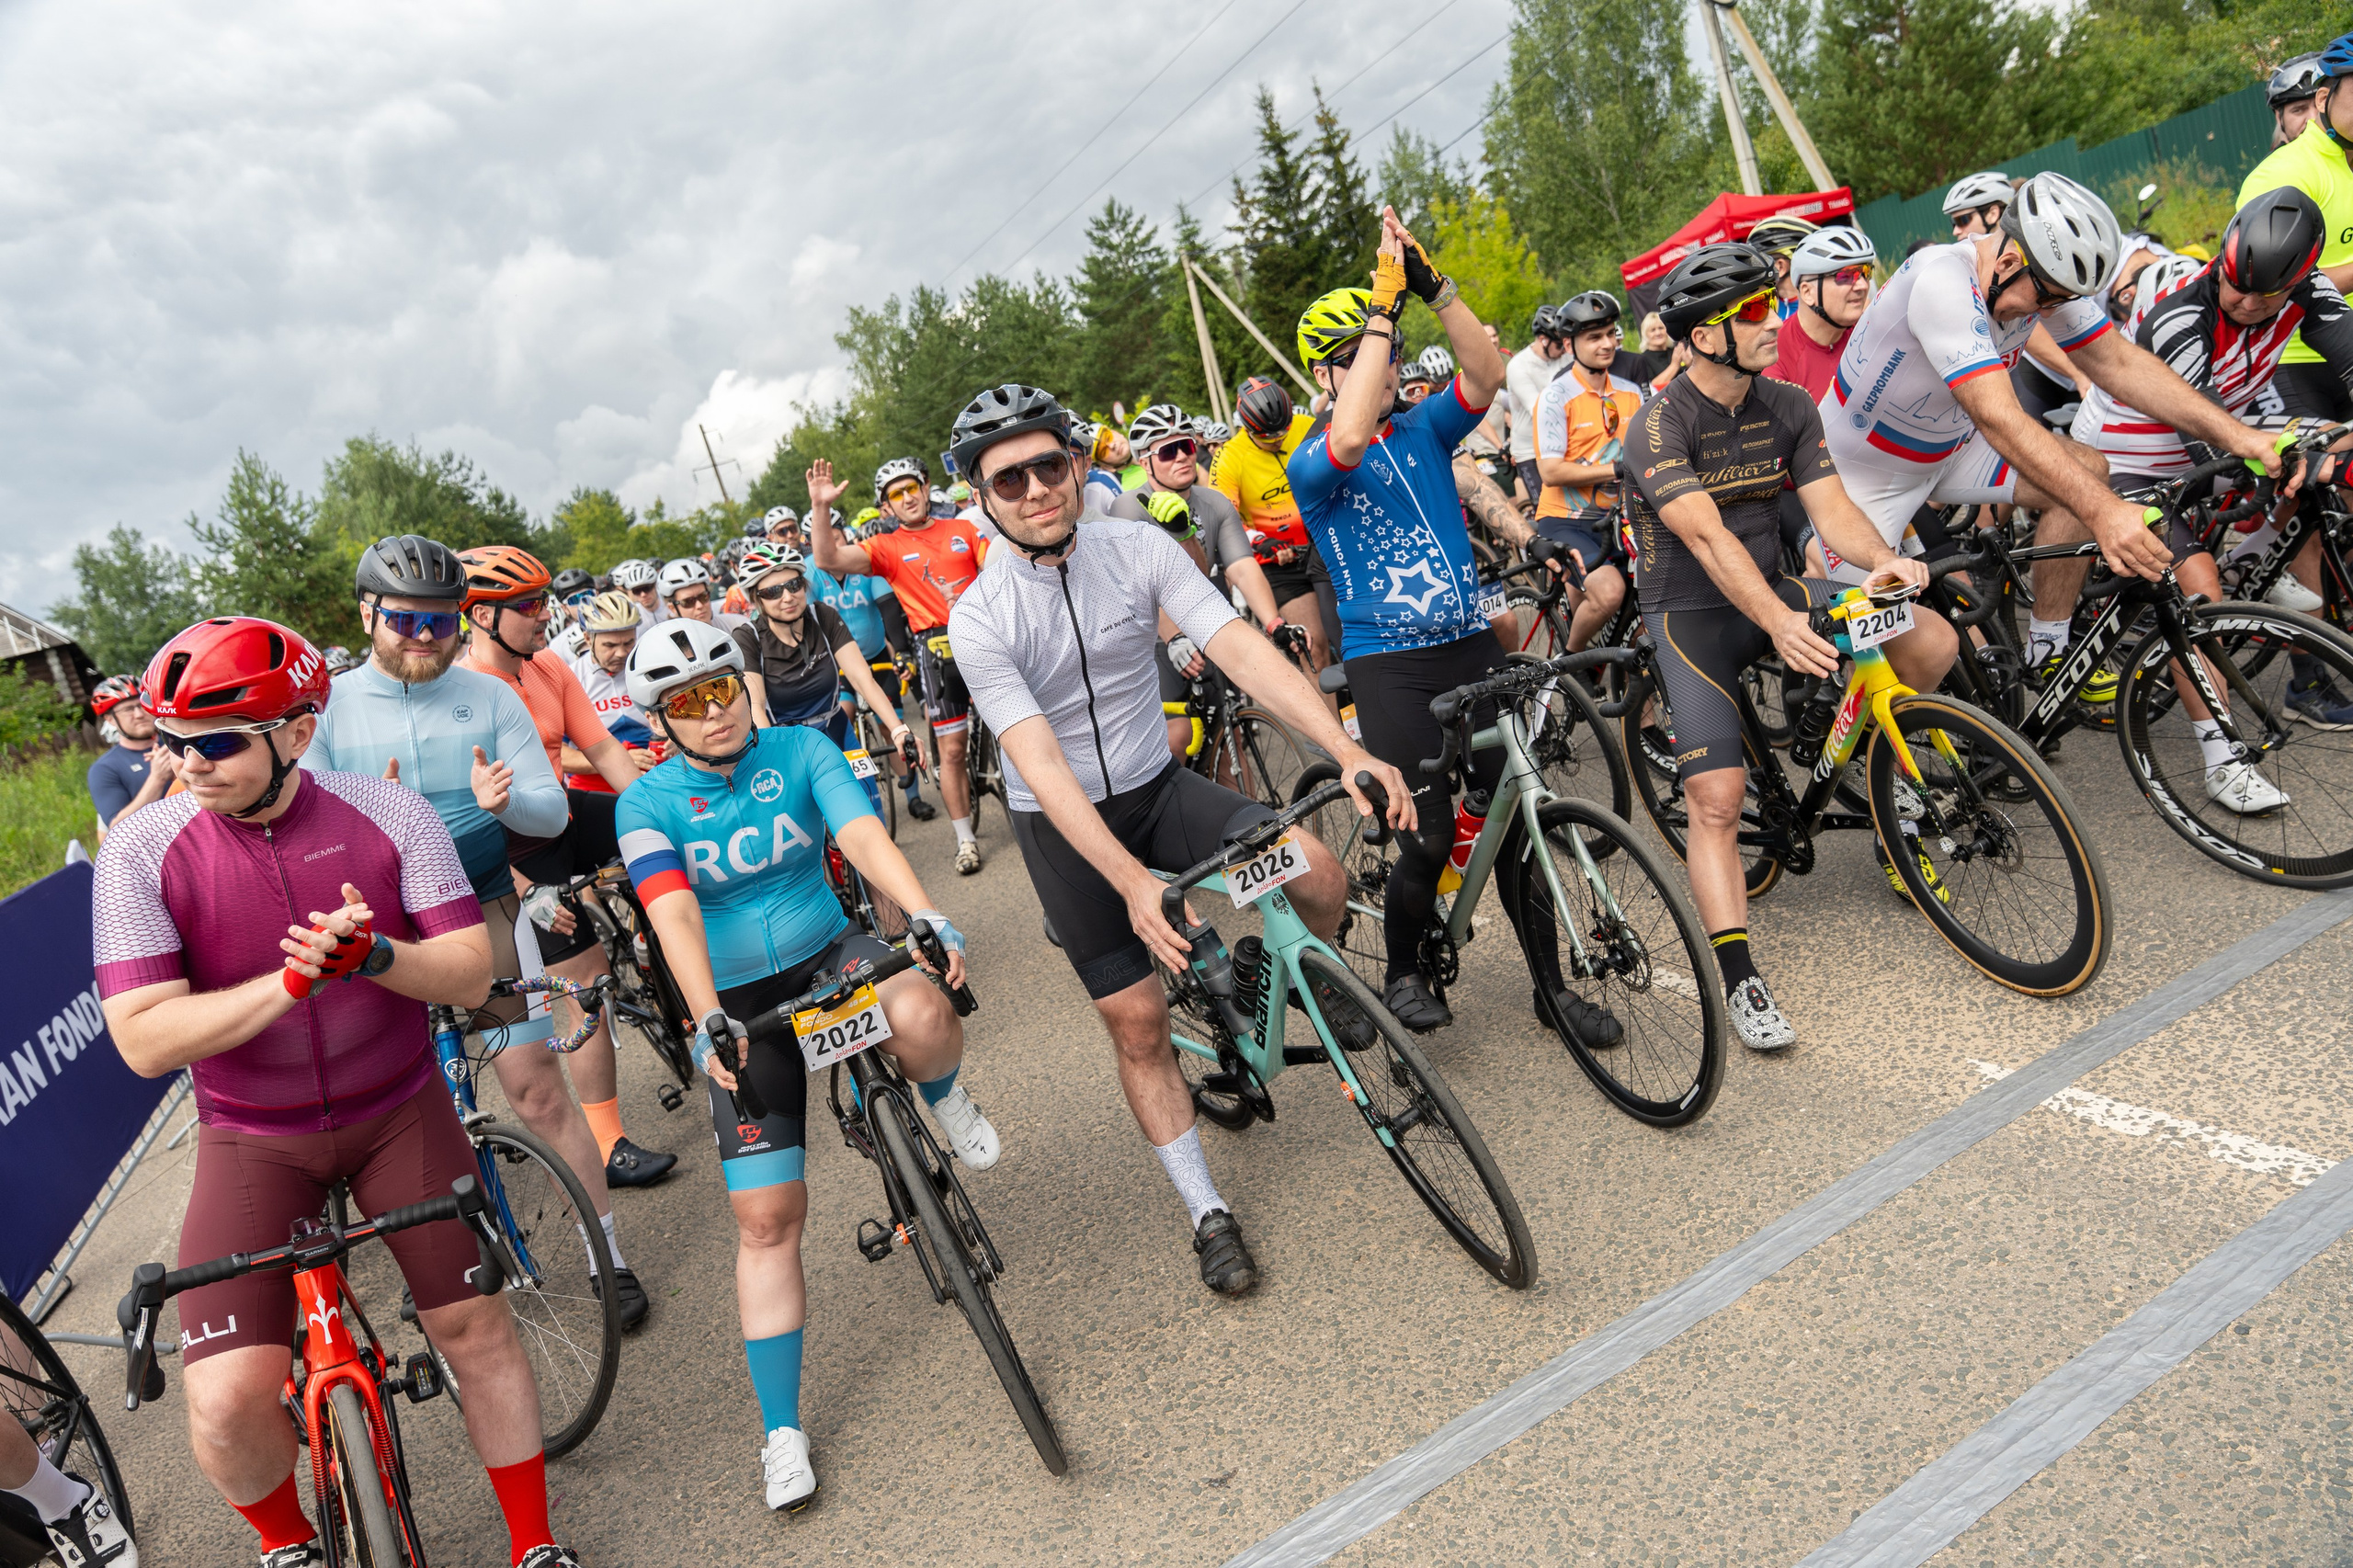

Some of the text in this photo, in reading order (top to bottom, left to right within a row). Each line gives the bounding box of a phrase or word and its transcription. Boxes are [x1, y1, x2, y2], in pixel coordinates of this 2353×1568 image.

[1861, 347, 1907, 414] GAZPROMBANK
[1645, 403, 1664, 454] Wilier
[1654, 476, 1700, 497] ВЕЛОМАРКЕТ
[1697, 463, 1771, 486] Wilier
[1328, 527, 1353, 601] GRAN FONDO
[823, 589, 869, 612] RCA
[1857, 605, 1906, 640] 2204
[688, 662, 706, 673] KASK
[2038, 604, 2121, 726] SCOTT
[2185, 651, 2234, 727] SCOTT
[156, 706, 177, 715] KASK
[1813, 694, 1855, 783] Wilier
[755, 776, 779, 795] RCA
[303, 843, 347, 863] BIEMME
[683, 812, 814, 885] RCA
[1234, 846, 1286, 893] 2026
[811, 1011, 879, 1057] 2022
[304, 1246, 329, 1257] GARMIN
[278, 1550, 307, 1563] SIDI
